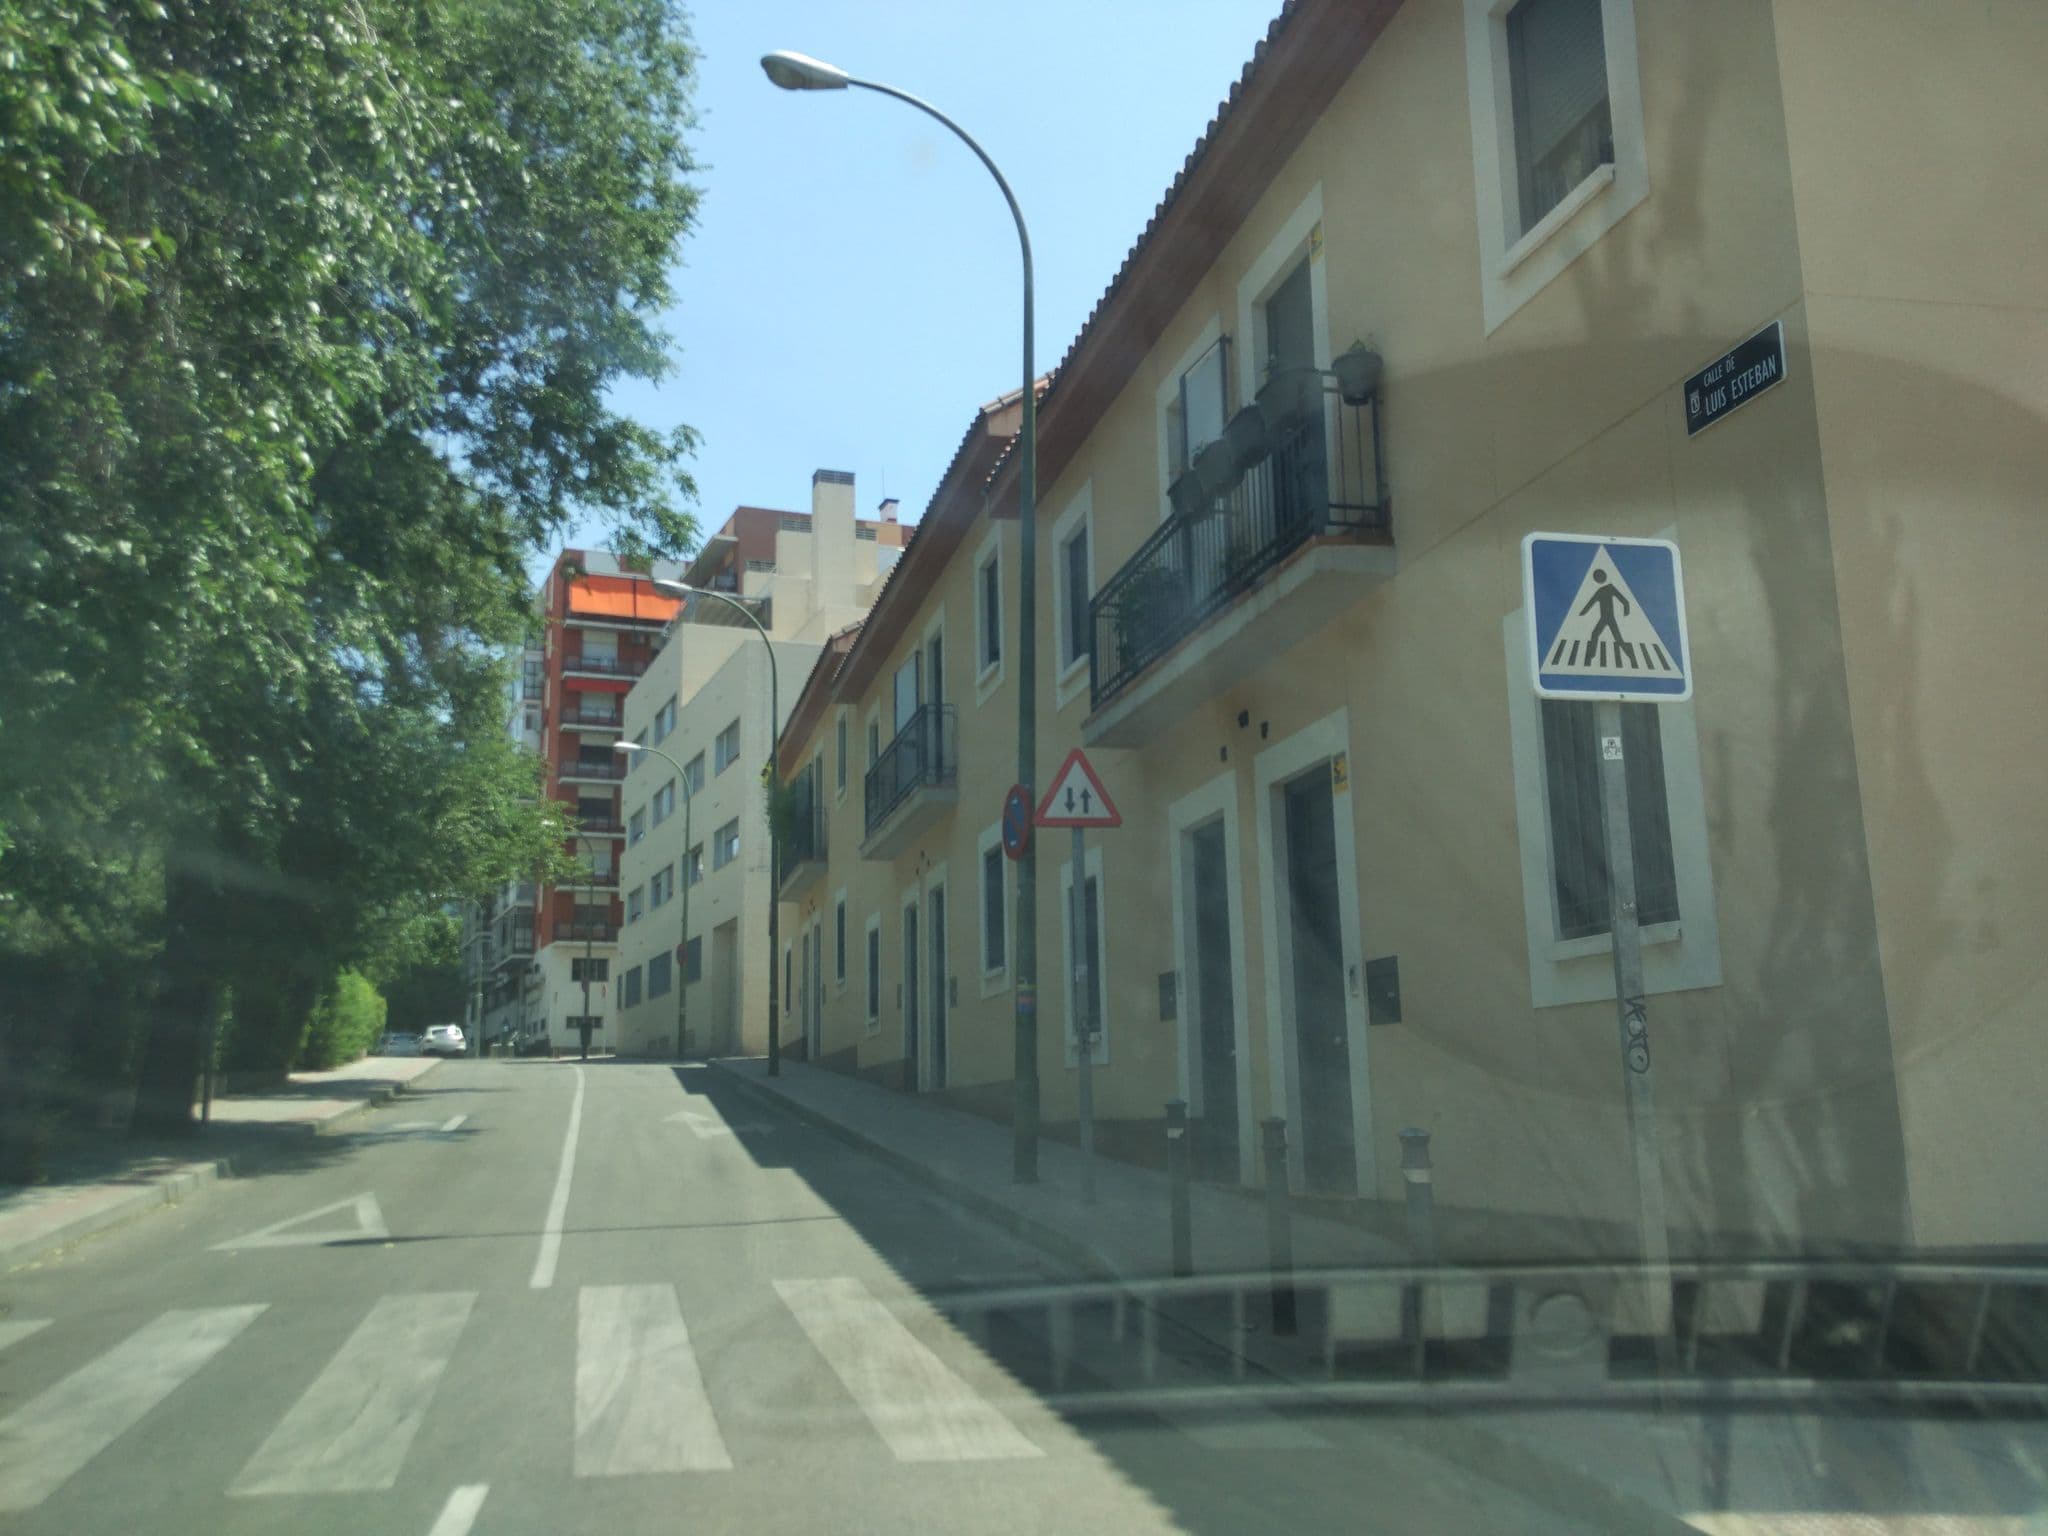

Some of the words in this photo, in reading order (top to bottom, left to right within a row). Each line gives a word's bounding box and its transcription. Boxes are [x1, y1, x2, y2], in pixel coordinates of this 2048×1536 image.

[1703, 365, 1723, 387] CALLE
[1726, 356, 1736, 373] DE
[1705, 386, 1727, 416] LUIS
[1731, 354, 1777, 399] ESTEBAN
